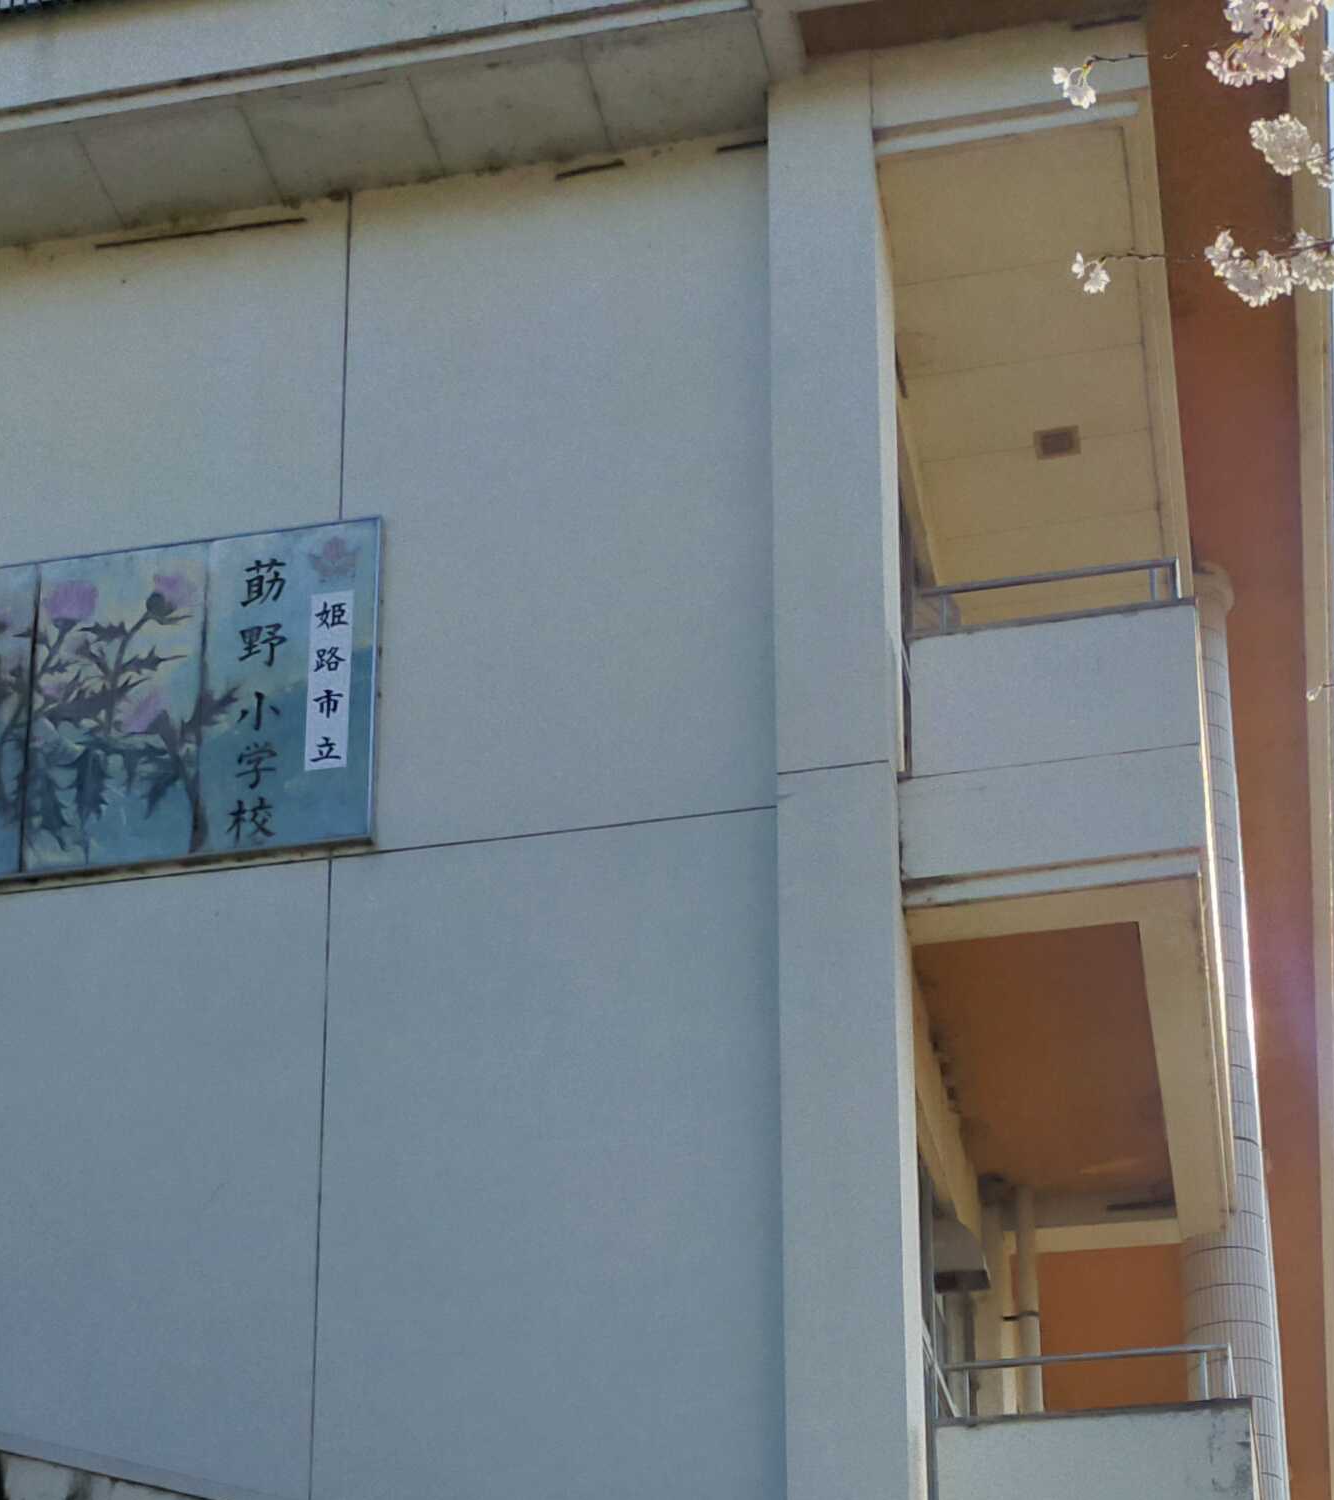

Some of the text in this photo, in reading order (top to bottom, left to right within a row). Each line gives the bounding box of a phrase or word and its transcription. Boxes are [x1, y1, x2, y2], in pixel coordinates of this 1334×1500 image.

[226, 557, 288, 844] 莇野小学校
[309, 601, 350, 763] 姫路市立
